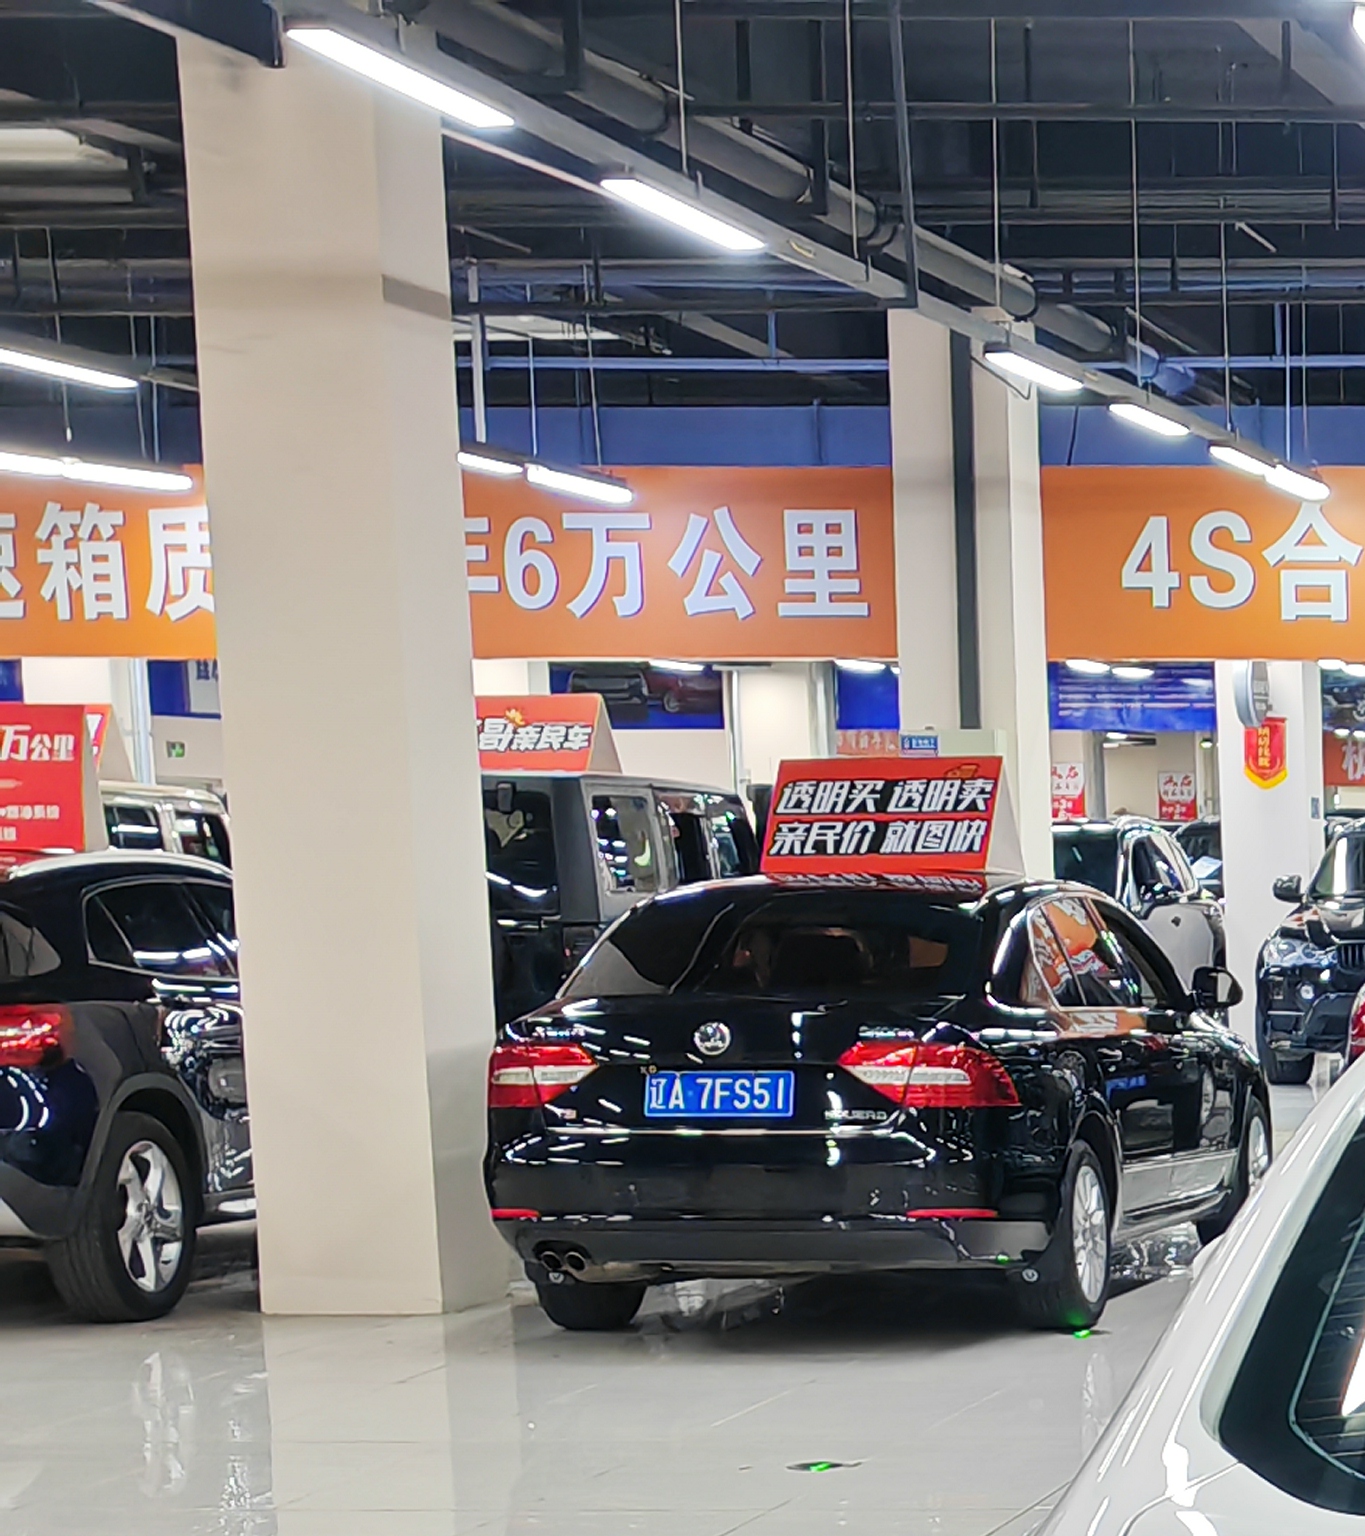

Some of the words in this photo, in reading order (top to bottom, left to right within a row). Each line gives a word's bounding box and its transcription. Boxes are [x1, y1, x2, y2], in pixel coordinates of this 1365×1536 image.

[0, 501, 214, 621] 箱质
[476, 718, 593, 752] 哥亲民车
[776, 780, 884, 814] 透明买
[887, 779, 995, 812] 透明卖
[769, 820, 876, 855] 亲民价
[880, 819, 988, 854] 就图快
